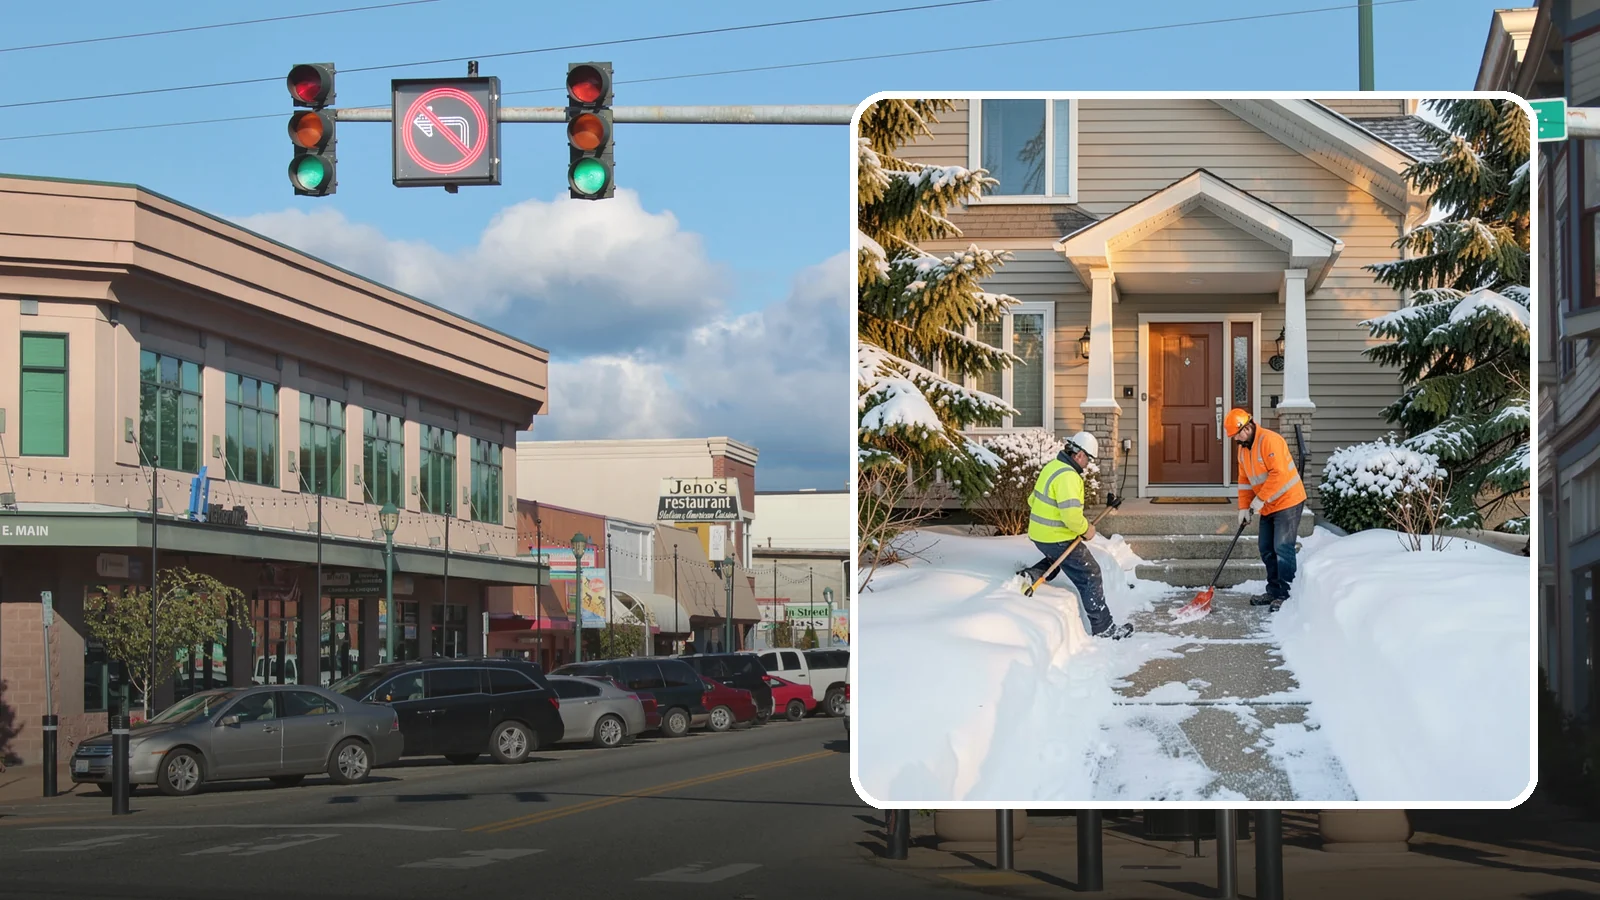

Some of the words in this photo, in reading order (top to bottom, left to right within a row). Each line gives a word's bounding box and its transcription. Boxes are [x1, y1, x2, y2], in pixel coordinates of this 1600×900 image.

[669, 479, 728, 495] Jeno's
[665, 496, 731, 509] restaurant
[658, 509, 682, 521] Italian
[686, 509, 715, 520] American
[714, 509, 737, 520] Cuisine
[2, 525, 13, 536] E.
[15, 525, 49, 536] MAIN
[797, 607, 829, 617] Street
